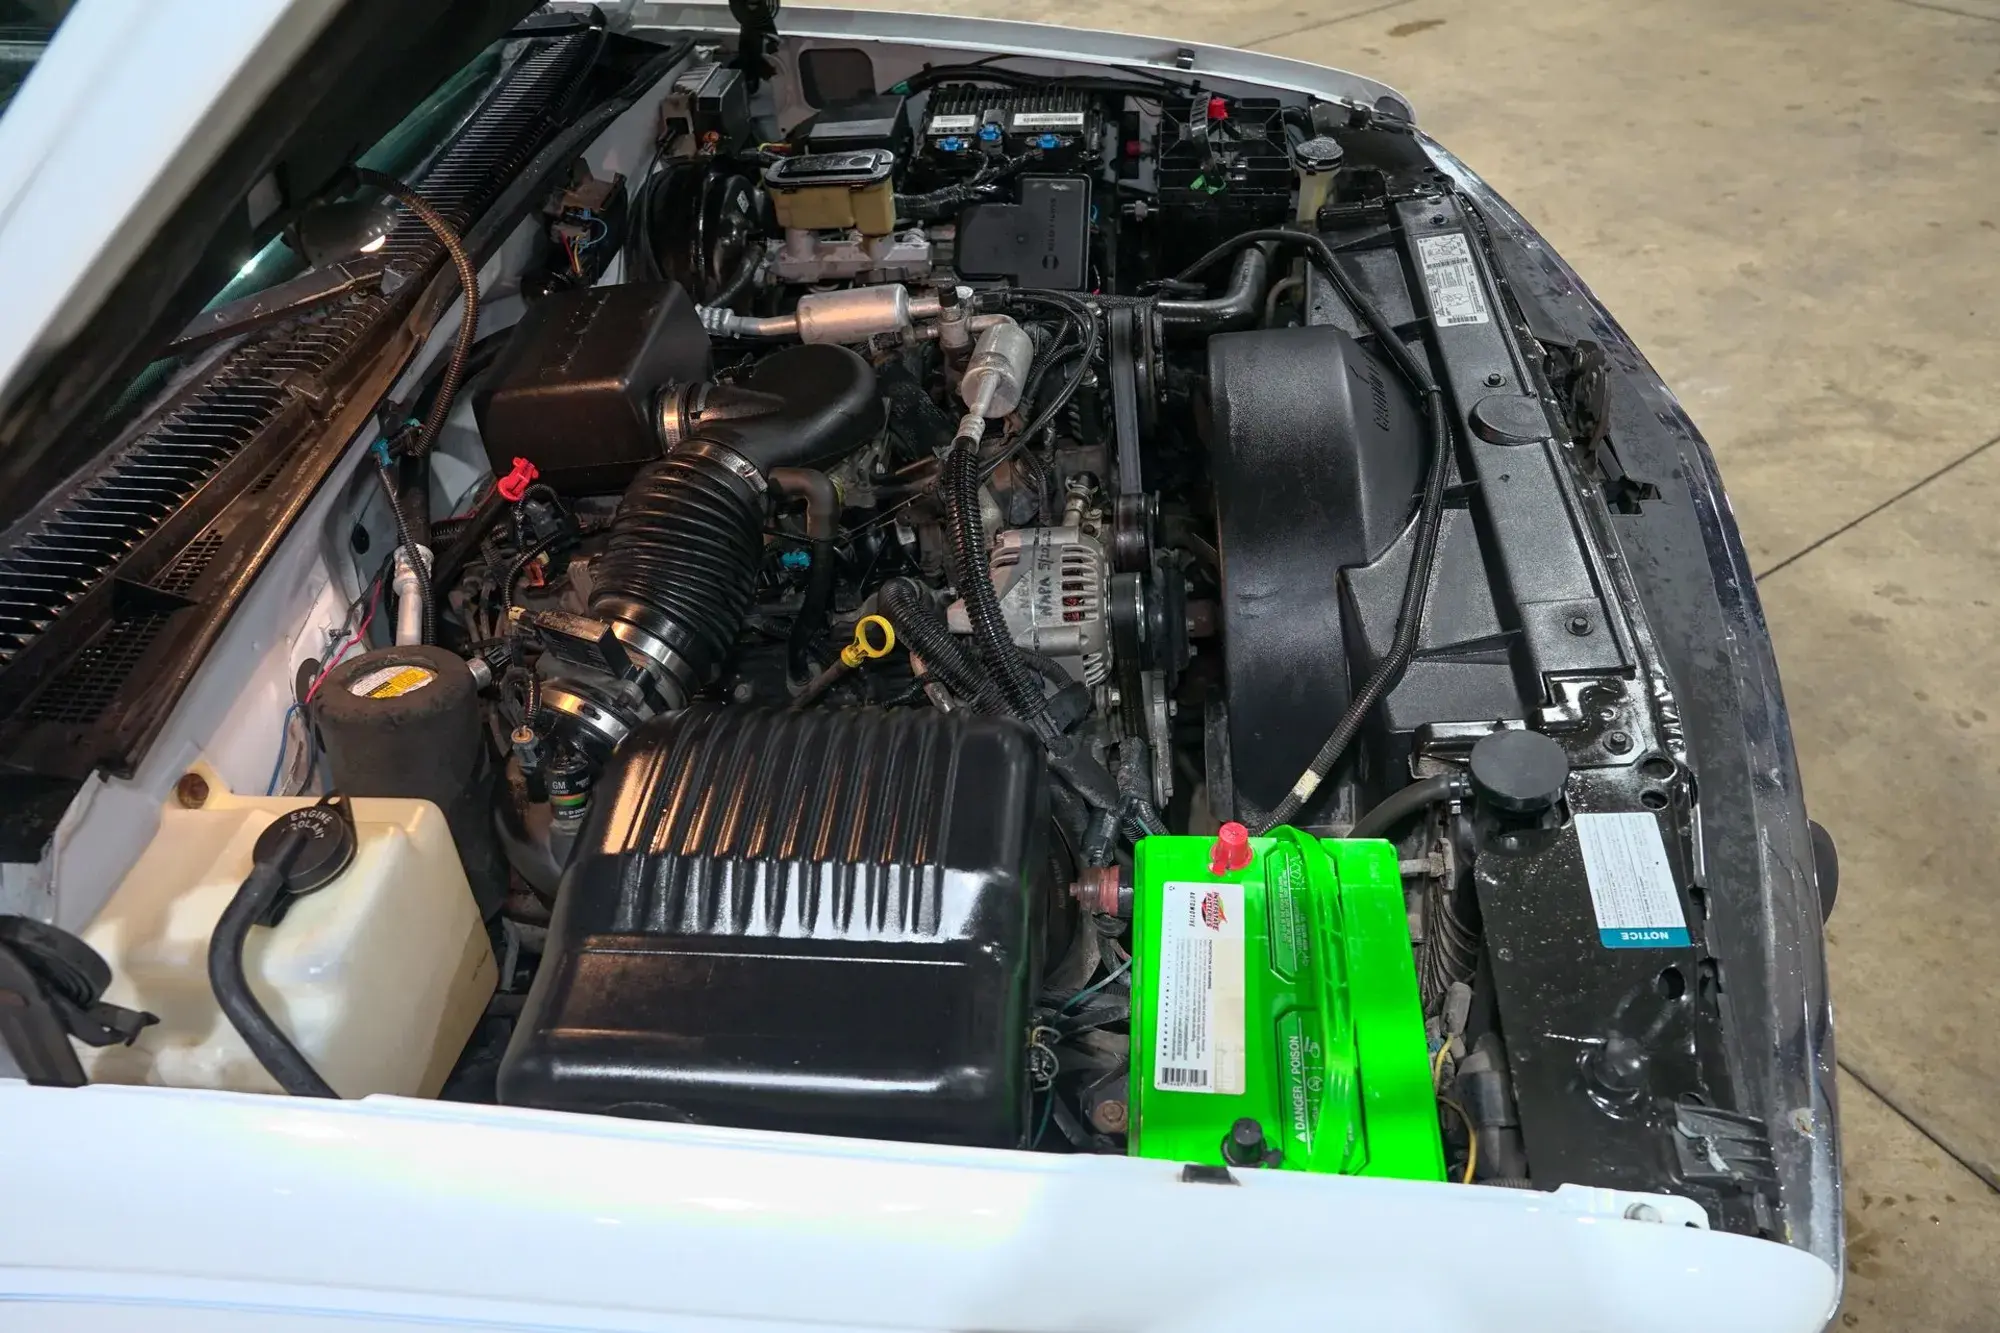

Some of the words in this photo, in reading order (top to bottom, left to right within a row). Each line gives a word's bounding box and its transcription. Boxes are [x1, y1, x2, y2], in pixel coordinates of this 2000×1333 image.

[1037, 575, 1053, 616] NAPA
[552, 781, 566, 790] GM
[281, 819, 325, 839] OOLANT
[290, 810, 333, 824] ENGINE
[1212, 891, 1220, 932] INTERSTATE
[1620, 931, 1670, 941] NOTICE
[1289, 1035, 1302, 1075] POISON
[1293, 1086, 1306, 1131] DANGER
